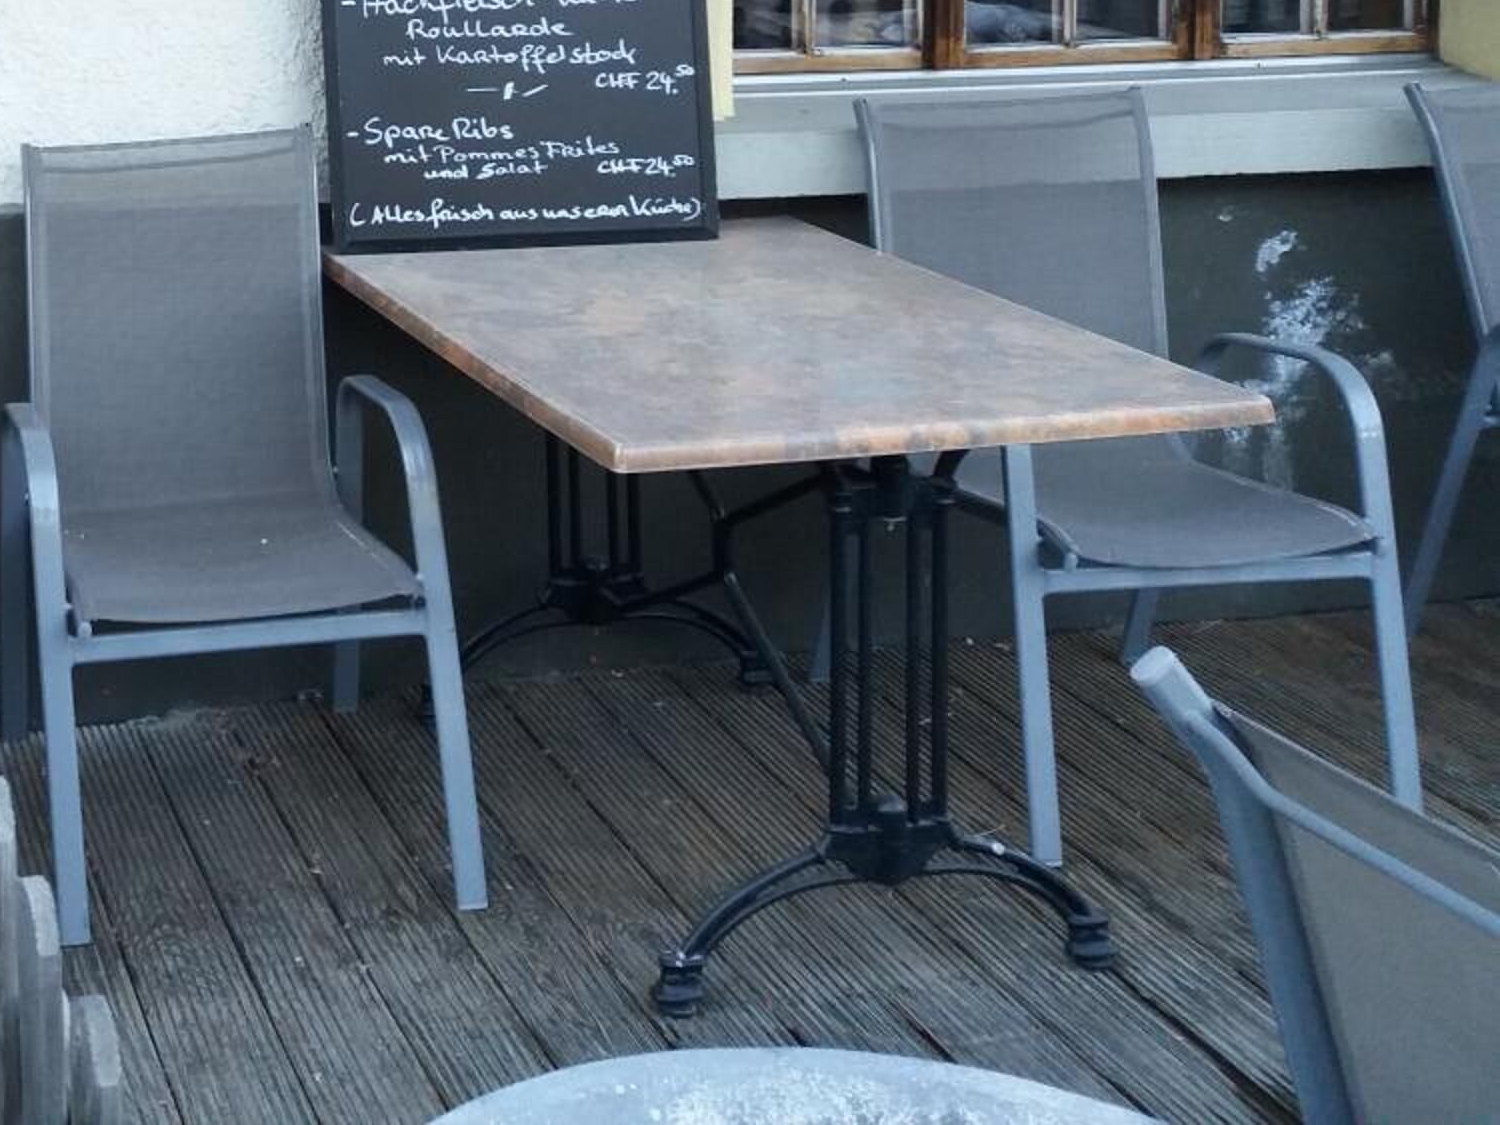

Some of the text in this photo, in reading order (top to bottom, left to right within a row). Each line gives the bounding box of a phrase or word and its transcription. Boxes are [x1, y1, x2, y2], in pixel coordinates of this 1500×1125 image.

[383, 46, 427, 66] mit
[595, 72, 642, 90] CHF
[451, 116, 514, 140] Ribs
[384, 135, 620, 163] mit Pommes Frites
[423, 164, 469, 179] und
[475, 159, 549, 179] Salat
[426, 197, 495, 229] frisch
[499, 208, 538, 221] aus
